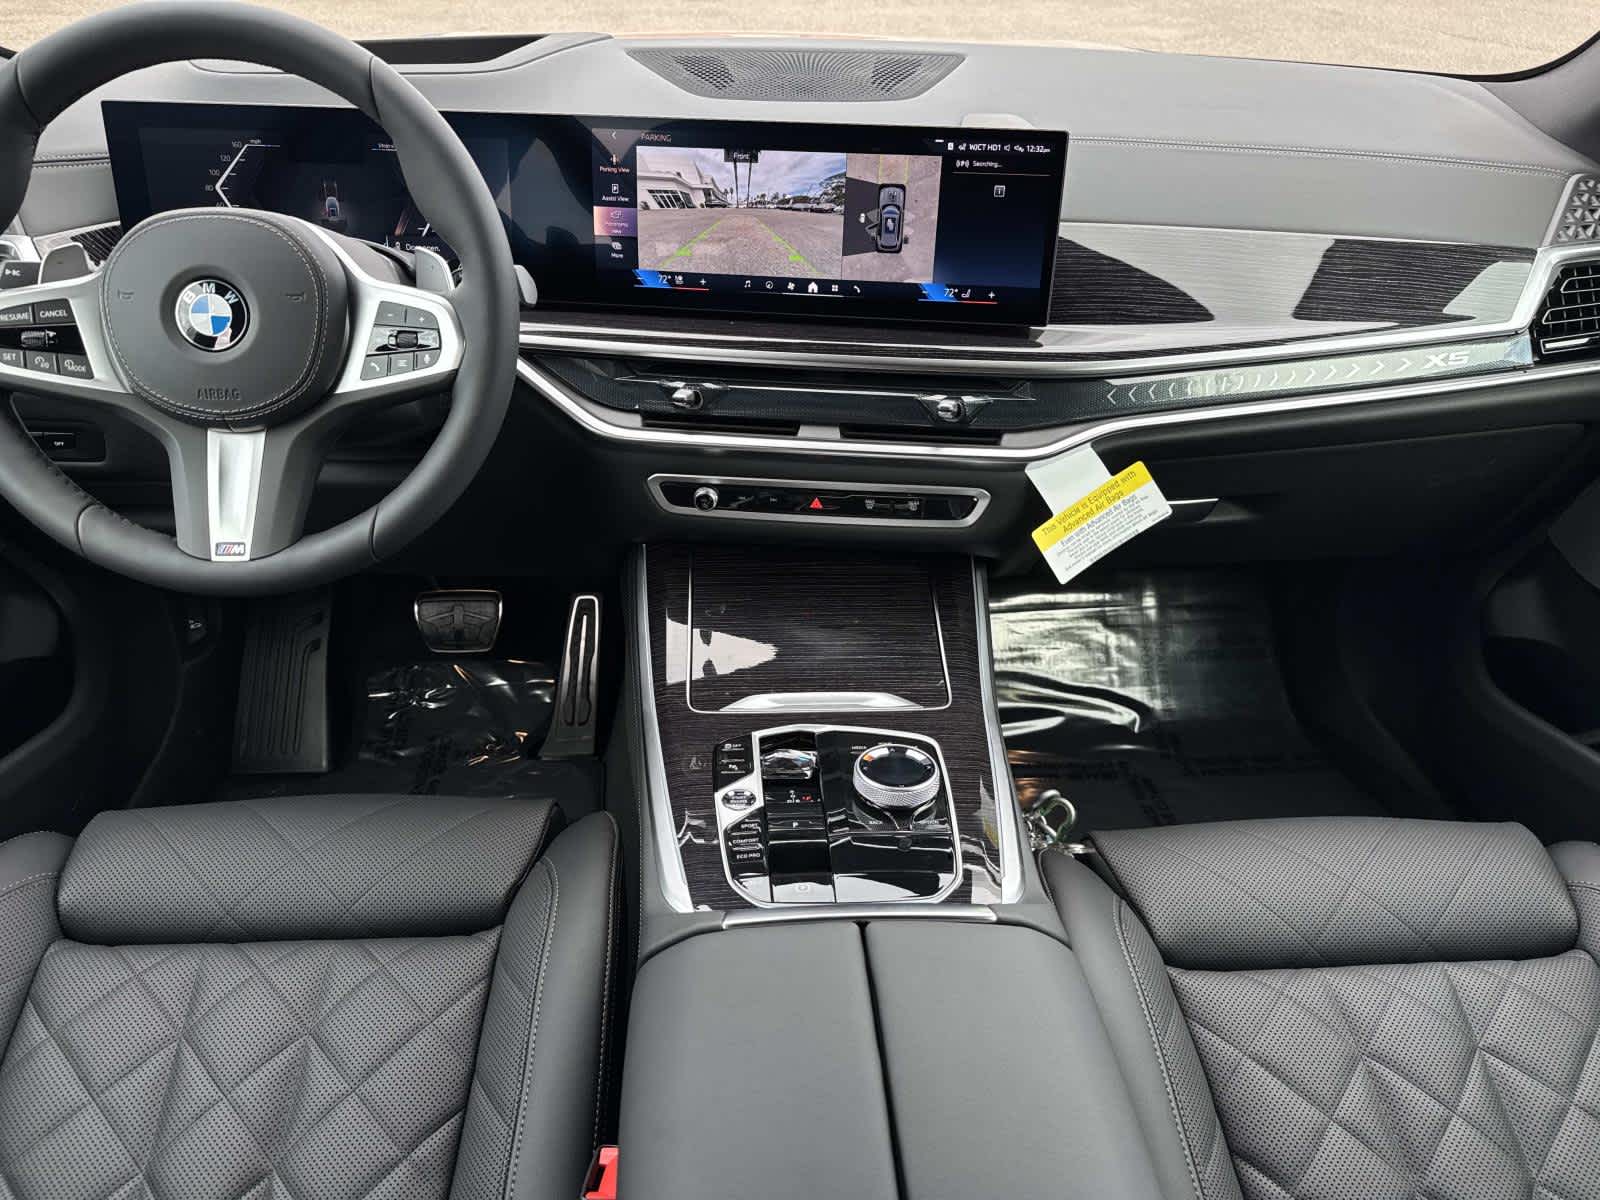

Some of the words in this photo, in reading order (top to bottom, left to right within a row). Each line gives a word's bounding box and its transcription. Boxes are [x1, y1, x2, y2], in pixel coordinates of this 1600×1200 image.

[641, 132, 672, 142] PARKING
[969, 143, 987, 151] WJCT
[39, 310, 68, 319] CANCEL
[2, 352, 17, 362] SET
[1423, 351, 1470, 369] X5
[197, 388, 240, 400] AIRBAG
[1057, 505, 1081, 526] Vehicle
[1087, 480, 1121, 506] Equipped
[1120, 470, 1137, 484] with
[1062, 507, 1095, 534] Advanced
[1094, 500, 1105, 513] Air
[1105, 490, 1124, 506] Bags
